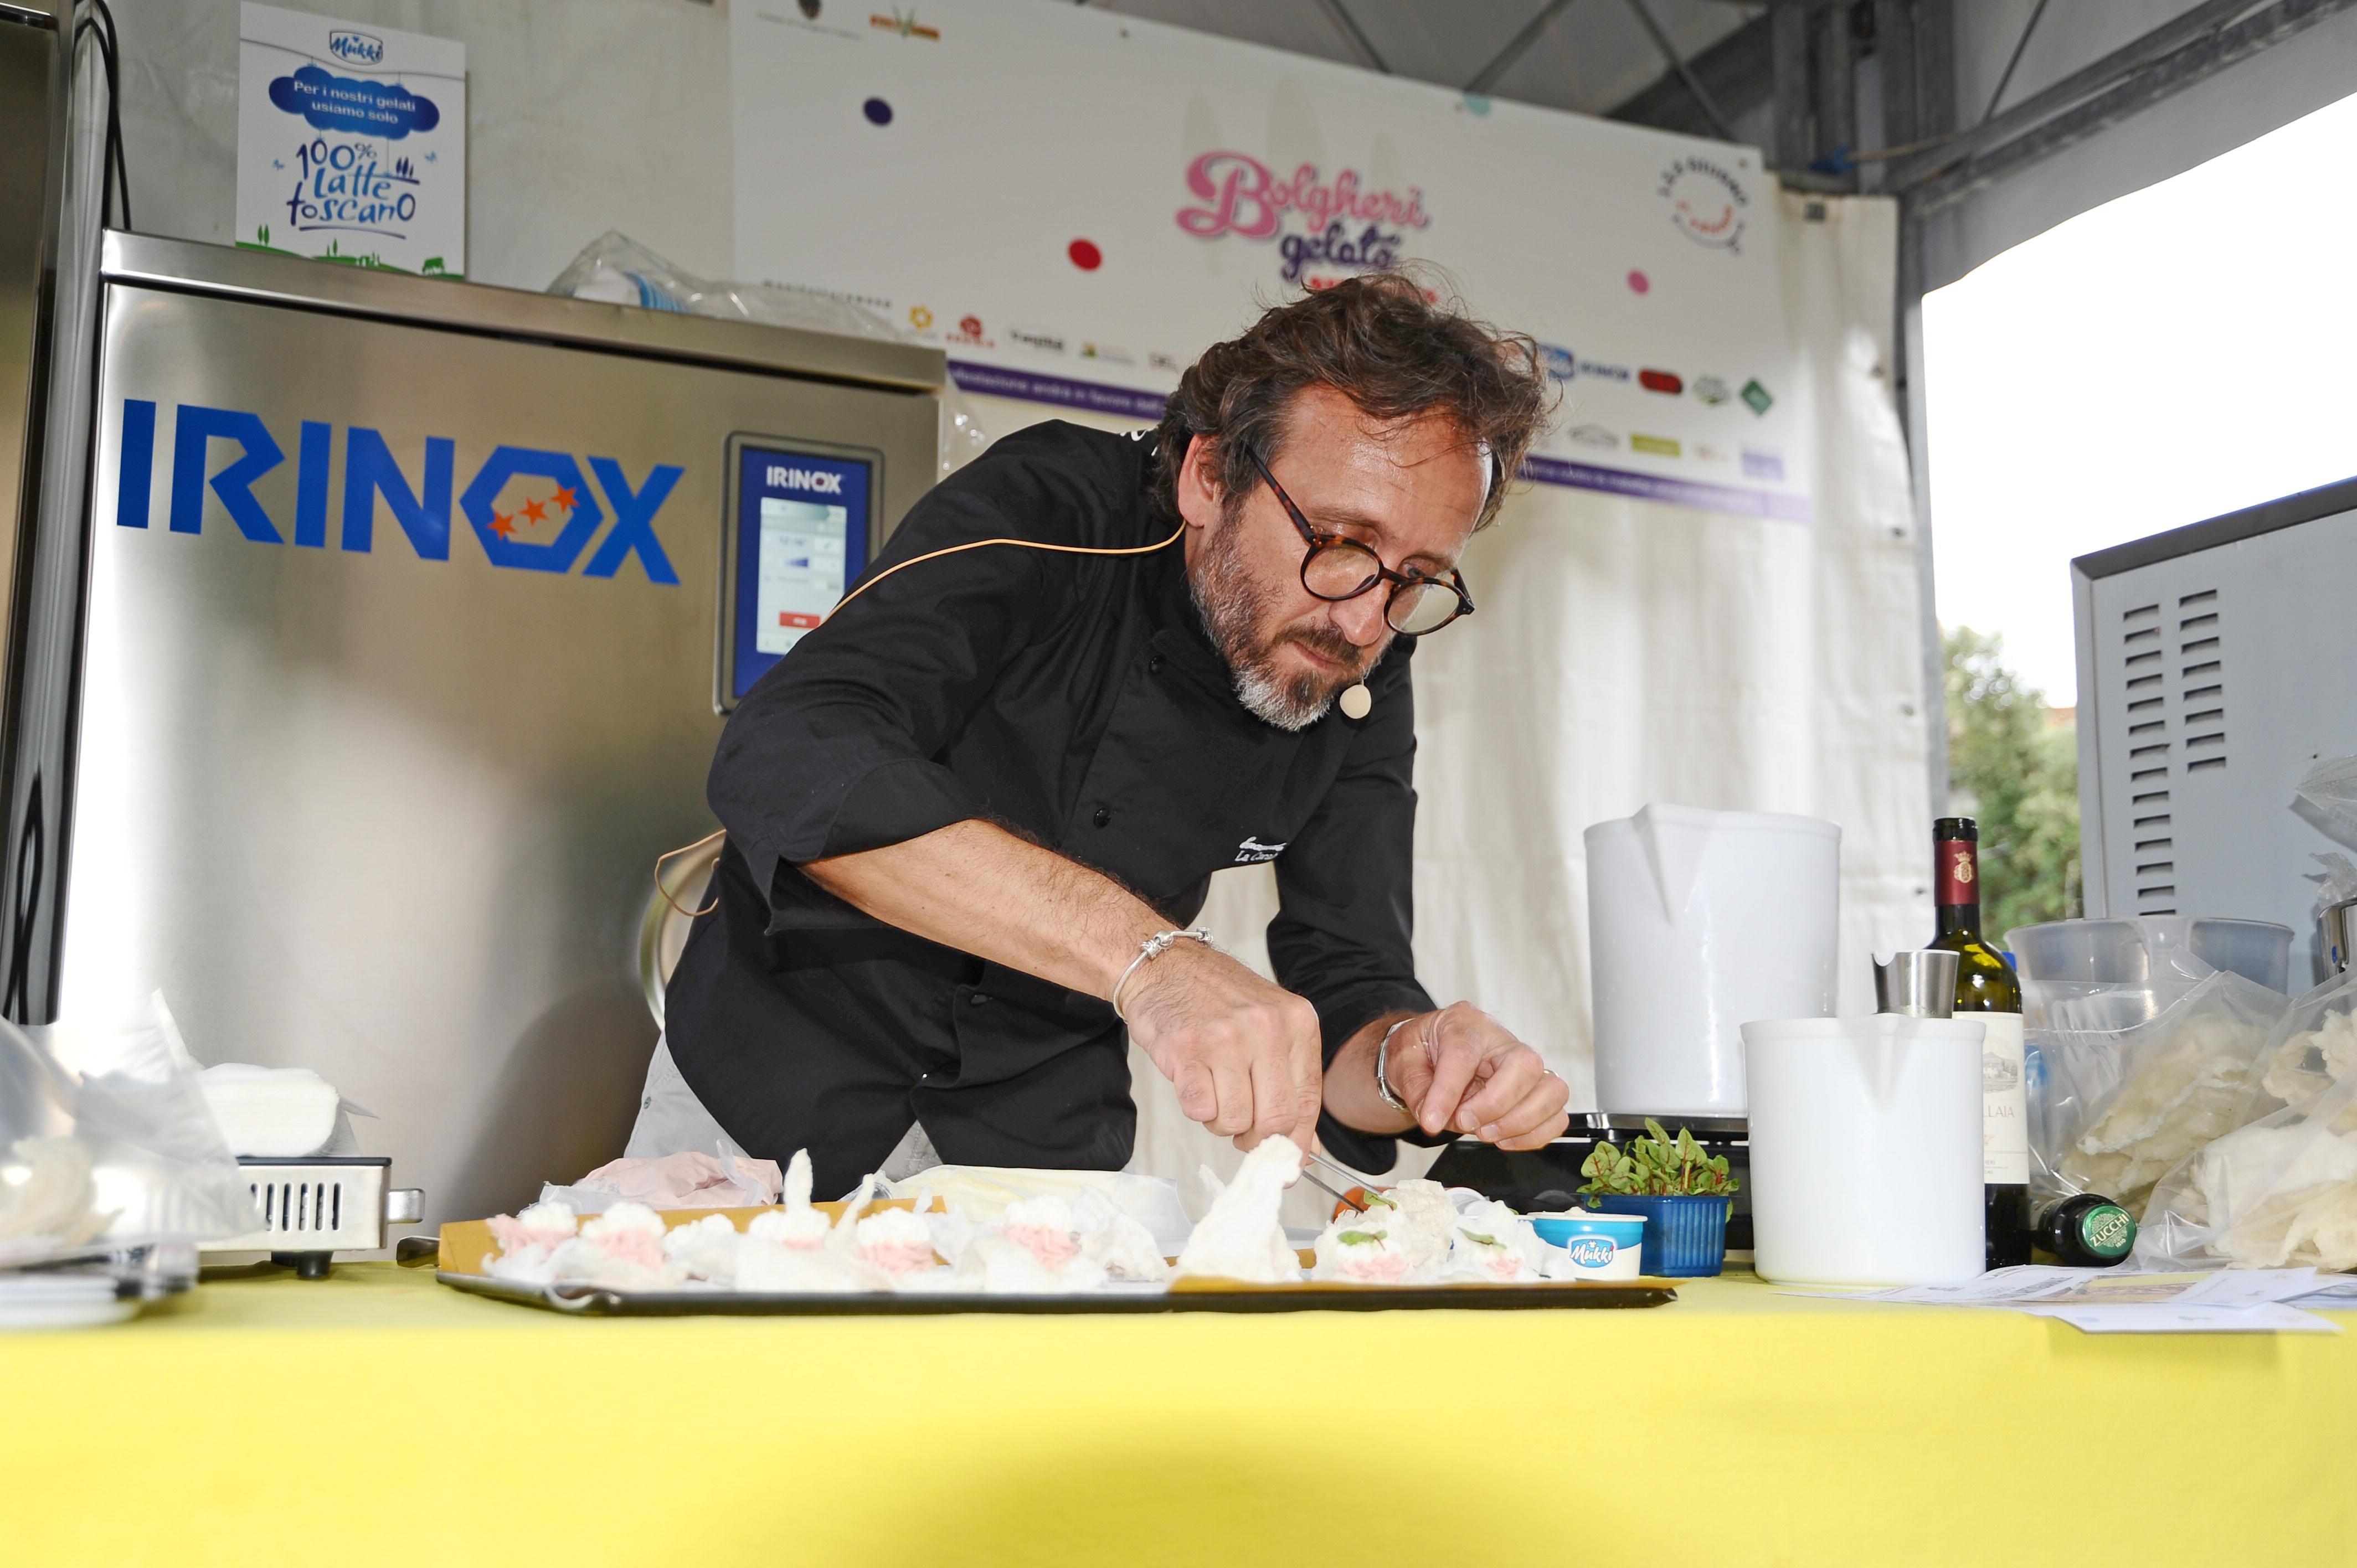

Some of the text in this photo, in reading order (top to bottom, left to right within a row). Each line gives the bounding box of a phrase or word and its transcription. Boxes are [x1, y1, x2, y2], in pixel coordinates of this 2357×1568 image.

[294, 81, 416, 112] Per i nostri gelati
[312, 101, 398, 125] usiamo solo
[296, 141, 377, 179] 100%
[1175, 150, 1431, 239] Bolgheri
[1280, 222, 1401, 282] gelato
[117, 398, 685, 586] IRINOX
[766, 465, 841, 494] IRINOX
[2090, 1214, 2129, 1247] ZUCCHI
[1570, 1244, 1614, 1265] Mukki
